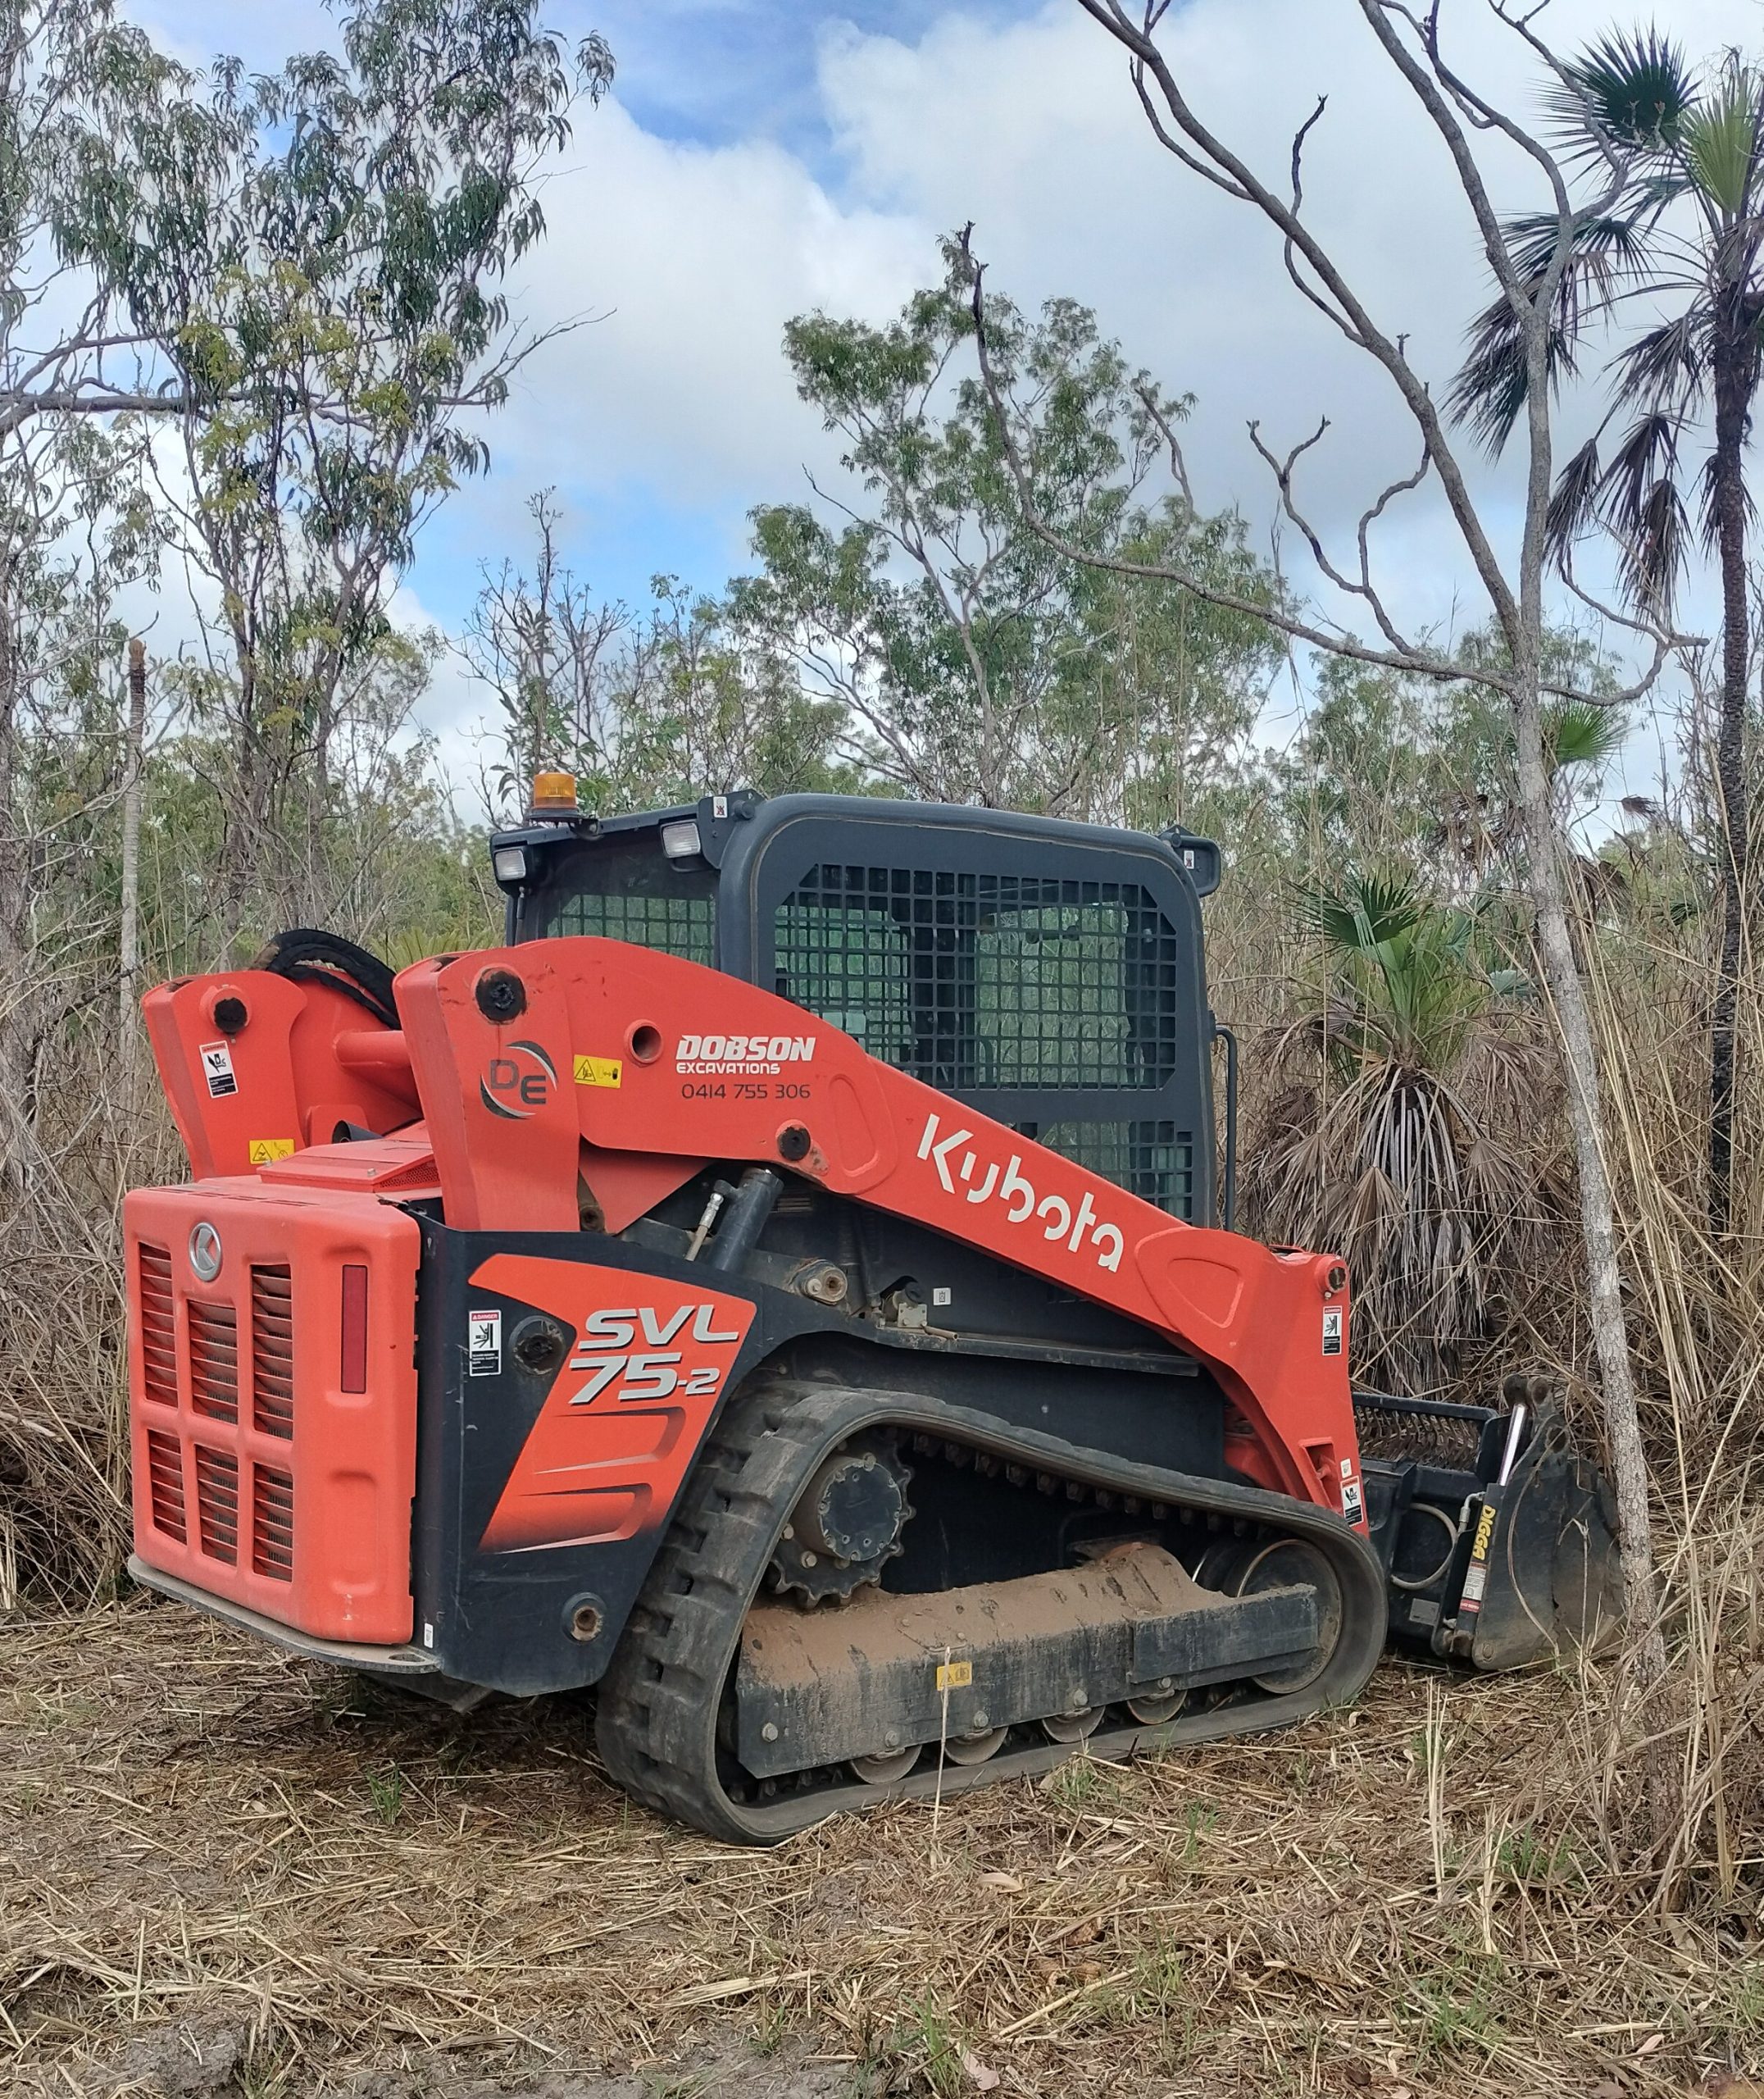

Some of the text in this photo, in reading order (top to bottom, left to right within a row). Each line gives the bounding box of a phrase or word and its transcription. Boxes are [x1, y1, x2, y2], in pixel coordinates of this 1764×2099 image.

[675, 1035, 816, 1062] DOBSON
[675, 1063, 781, 1075] EXCAVATIONS
[681, 1084, 811, 1100] 0414 755 306
[916, 1113, 1125, 1273] Kubota
[577, 1304, 739, 1350] SVL
[569, 1352, 720, 1405] 75-2
[1472, 1505, 1497, 1561] DIGGA
